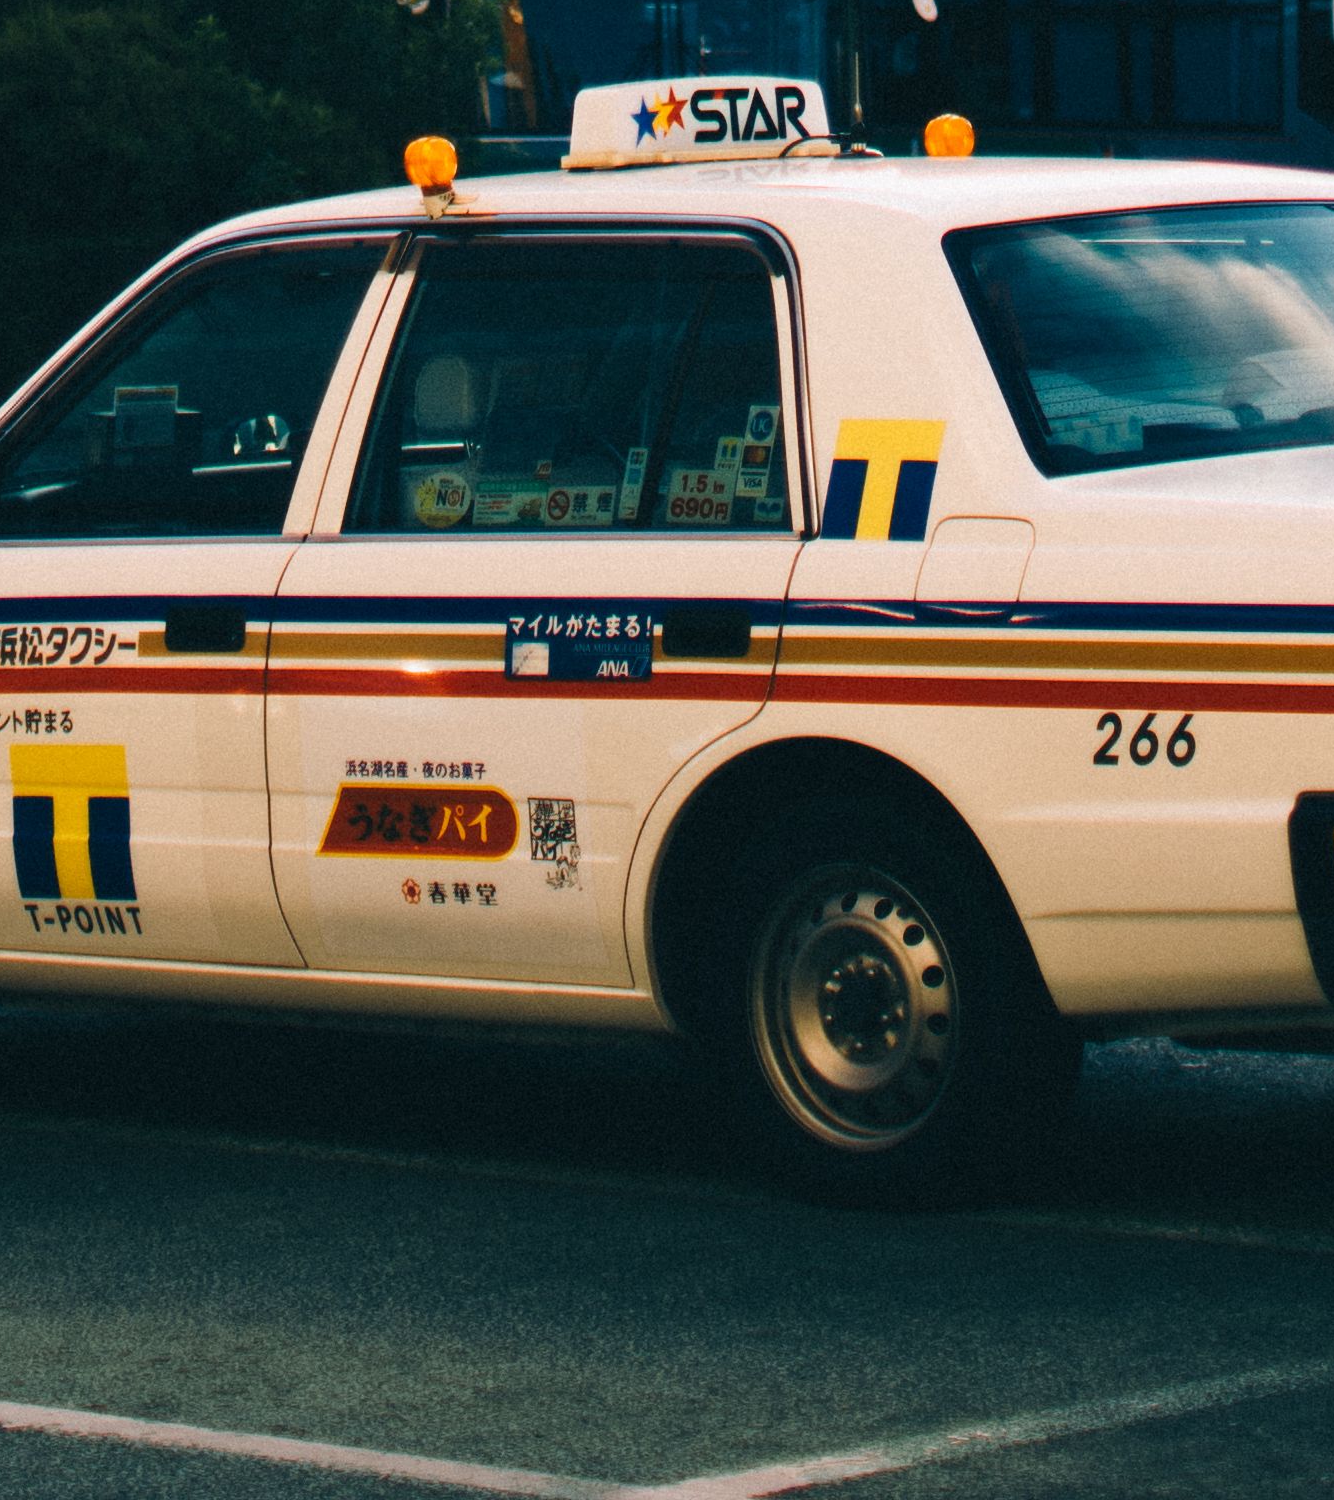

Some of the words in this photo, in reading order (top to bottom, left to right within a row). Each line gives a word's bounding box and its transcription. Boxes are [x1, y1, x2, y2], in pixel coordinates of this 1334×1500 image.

[690, 86, 810, 144] STAR
[681, 474, 709, 494] 1.5
[670, 497, 729, 521] 690円
[596, 659, 629, 678] ANA
[1092, 712, 1197, 768] 266
[348, 803, 493, 844] うなぎパイ
[426, 880, 499, 906] 春華堂
[23, 903, 144, 937] T-POINT
